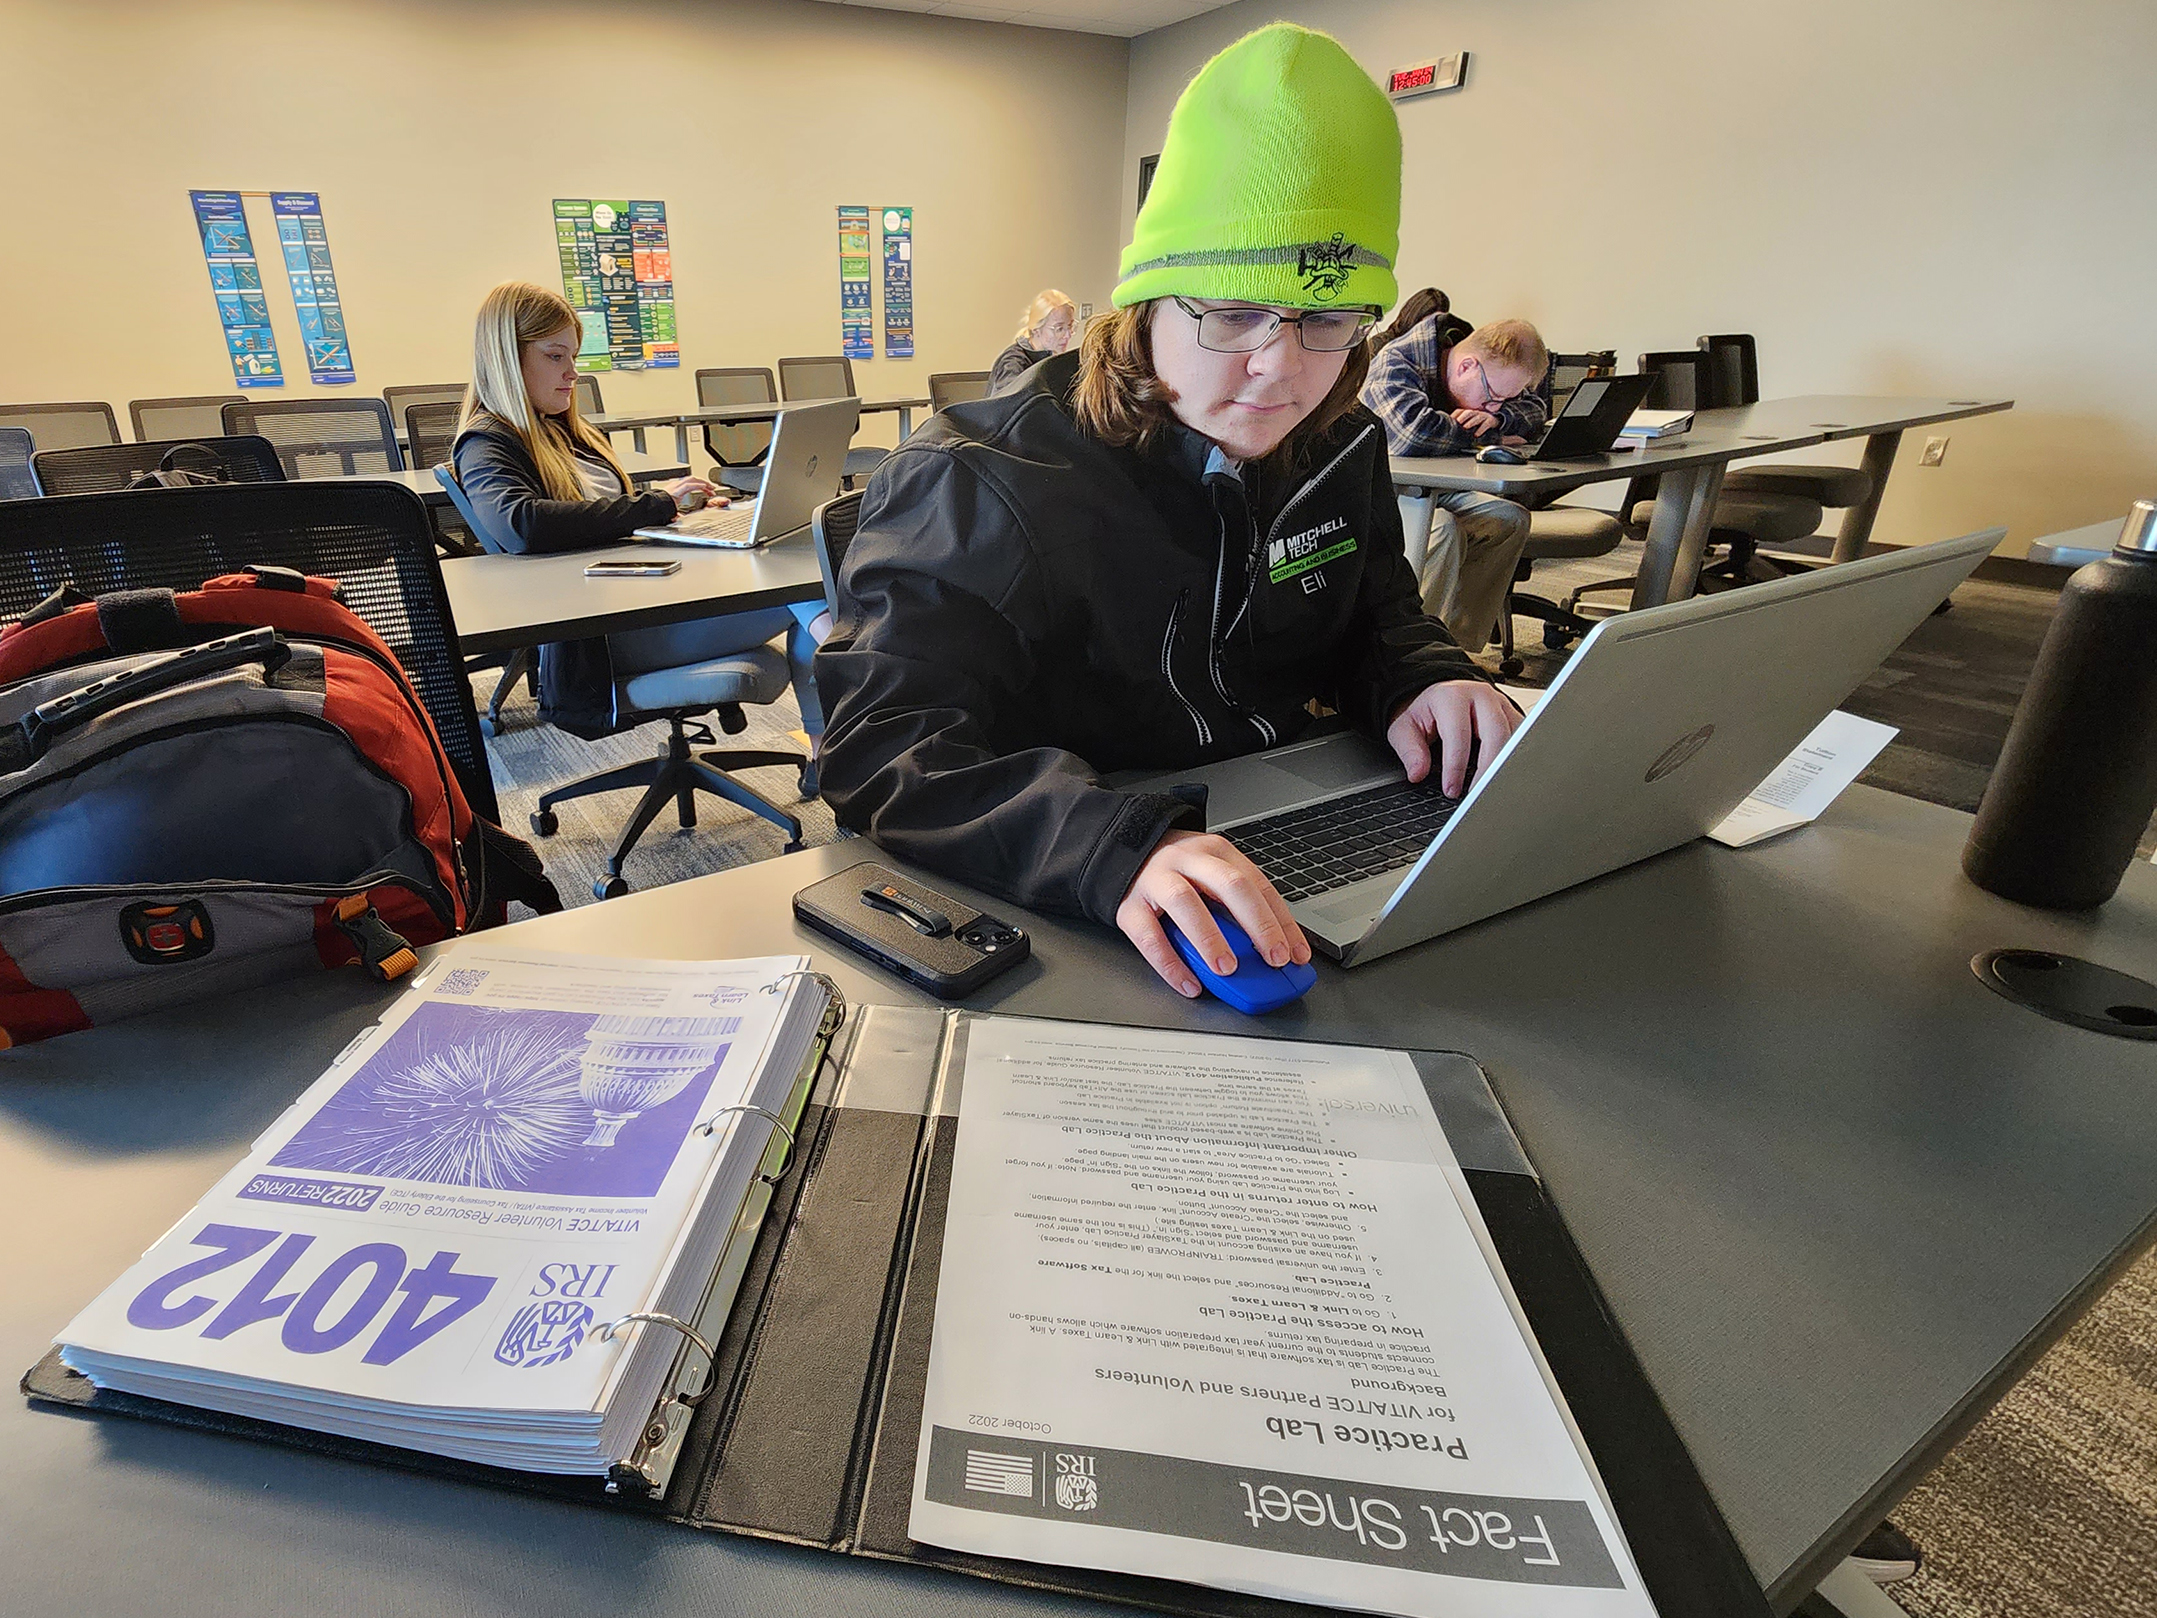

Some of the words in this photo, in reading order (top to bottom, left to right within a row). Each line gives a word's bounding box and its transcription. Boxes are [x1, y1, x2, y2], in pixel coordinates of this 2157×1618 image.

[1394, 74, 1432, 91] 12:45:00
[1287, 516, 1347, 549] MITCHELL
[1289, 539, 1318, 559] TECH
[1272, 562, 1304, 580] ACCOUNTING
[1305, 555, 1320, 566] AND
[1321, 541, 1356, 560] BUSINESS
[1301, 571, 1327, 594] Eli
[1062, 1126, 1082, 1135] Lab
[1086, 1128, 1131, 1139] Practice
[1155, 1135, 1190, 1144] About
[1193, 1138, 1260, 1150] Information
[1263, 1143, 1321, 1156] Important
[1324, 1150, 1358, 1159] Other
[247, 1180, 327, 1199] RETURNS
[1131, 1183, 1153, 1192] Lab
[1157, 1186, 1206, 1198] Practice
[321, 1186, 379, 1207] 2022
[390, 1189, 410, 1197] (TCE)
[410, 1192, 434, 1200] Elderly
[1210, 1191, 1230, 1199] the
[1233, 1193, 1245, 1201] in
[457, 1196, 496, 1207] Counseling
[1248, 1194, 1293, 1204] returns
[1297, 1199, 1329, 1207] enter
[379, 1201, 420, 1216] Guide
[514, 1203, 535, 1211] (VITA)
[536, 1205, 574, 1213] Assistance
[1349, 1204, 1378, 1213] How
[424, 1206, 493, 1224] Resource
[494, 1215, 562, 1230] Volunteer
[566, 1219, 640, 1232] VITA/TCE
[1082, 1227, 1101, 1235] Lab,
[1104, 1230, 1140, 1240] Practice
[1142, 1230, 1188, 1245] TaxSlayer
[1190, 1238, 1205, 1246] the
[1092, 1240, 1129, 1250] capitals,
[1218, 1241, 1254, 1250] account
[1257, 1244, 1293, 1254] existing
[1147, 1247, 1224, 1261] TRAINPROWEB
[1309, 1250, 1333, 1259] have
[1226, 1255, 1274, 1264] password:
[1038, 1260, 1088, 1271] Software
[1091, 1265, 1113, 1274] Tax
[1276, 1260, 1320, 1270] universal
[1322, 1264, 1338, 1272] the
[1147, 1271, 1163, 1280] link
[1340, 1266, 1366, 1275] Enter
[527, 1263, 620, 1299] IRS
[1166, 1273, 1181, 1281] the
[1183, 1275, 1211, 1284] select
[1292, 1276, 1317, 1284] Lab.
[1320, 1278, 1371, 1290] Practice
[126, 1223, 498, 1366] 4012
[1359, 1293, 1375, 1302] Go
[1382, 1295, 1392, 1303] 2.
[1229, 1296, 1269, 1307] Taxes.
[1272, 1301, 1306, 1311] Learn
[1200, 1307, 1225, 1319] Lab
[1322, 1306, 1350, 1316] Link
[1365, 1310, 1380, 1318] Go
[1010, 1313, 1054, 1325] hands-on
[1057, 1318, 1087, 1327] allows
[1230, 1310, 1287, 1325] Practice
[1291, 1317, 1314, 1328] the
[1030, 1326, 1046, 1334] link
[1090, 1321, 1118, 1331] which
[1121, 1325, 1162, 1336] software
[1317, 1319, 1368, 1332] access
[1372, 1325, 1387, 1335] to
[1060, 1329, 1092, 1340] Taxes.
[1095, 1332, 1123, 1343] Learn
[1165, 1331, 1222, 1342] preparation
[1392, 1327, 1424, 1338] How
[1126, 1336, 1134, 1344] &
[1136, 1337, 1157, 1347] Link
[1160, 1340, 1181, 1349] with
[1224, 1337, 1240, 1346] tax
[1243, 1339, 1266, 1348] year
[1183, 1343, 1234, 1356] integrated
[1268, 1342, 1304, 1352] current
[1307, 1346, 1324, 1355] the
[1326, 1348, 1337, 1356] to
[1237, 1349, 1245, 1358] is
[1248, 1350, 1268, 1360] that
[1271, 1353, 1315, 1364] software
[1339, 1350, 1384, 1361] students
[1317, 1358, 1334, 1367] tax
[1387, 1354, 1435, 1364] connects
[1336, 1360, 1346, 1369] is
[1348, 1362, 1369, 1372] Lab
[1371, 1364, 1416, 1376] Practice
[1418, 1368, 1439, 1378] The
[1095, 1369, 1195, 1394] Volunteers
[1200, 1382, 1234, 1395] and
[1351, 1379, 1447, 1398] Background
[1240, 1386, 1322, 1409] Partners
[1326, 1396, 1423, 1420] VITA/TCE
[1427, 1407, 1456, 1422] for
[969, 1414, 999, 1428] 2022
[1002, 1419, 1052, 1435] October
[1266, 1417, 1325, 1445] Lab
[1334, 1425, 1469, 1461] Practice
[1055, 1453, 1096, 1476] IRS
[1240, 1482, 1407, 1550] Sheet
[1420, 1505, 1560, 1566] Fact
